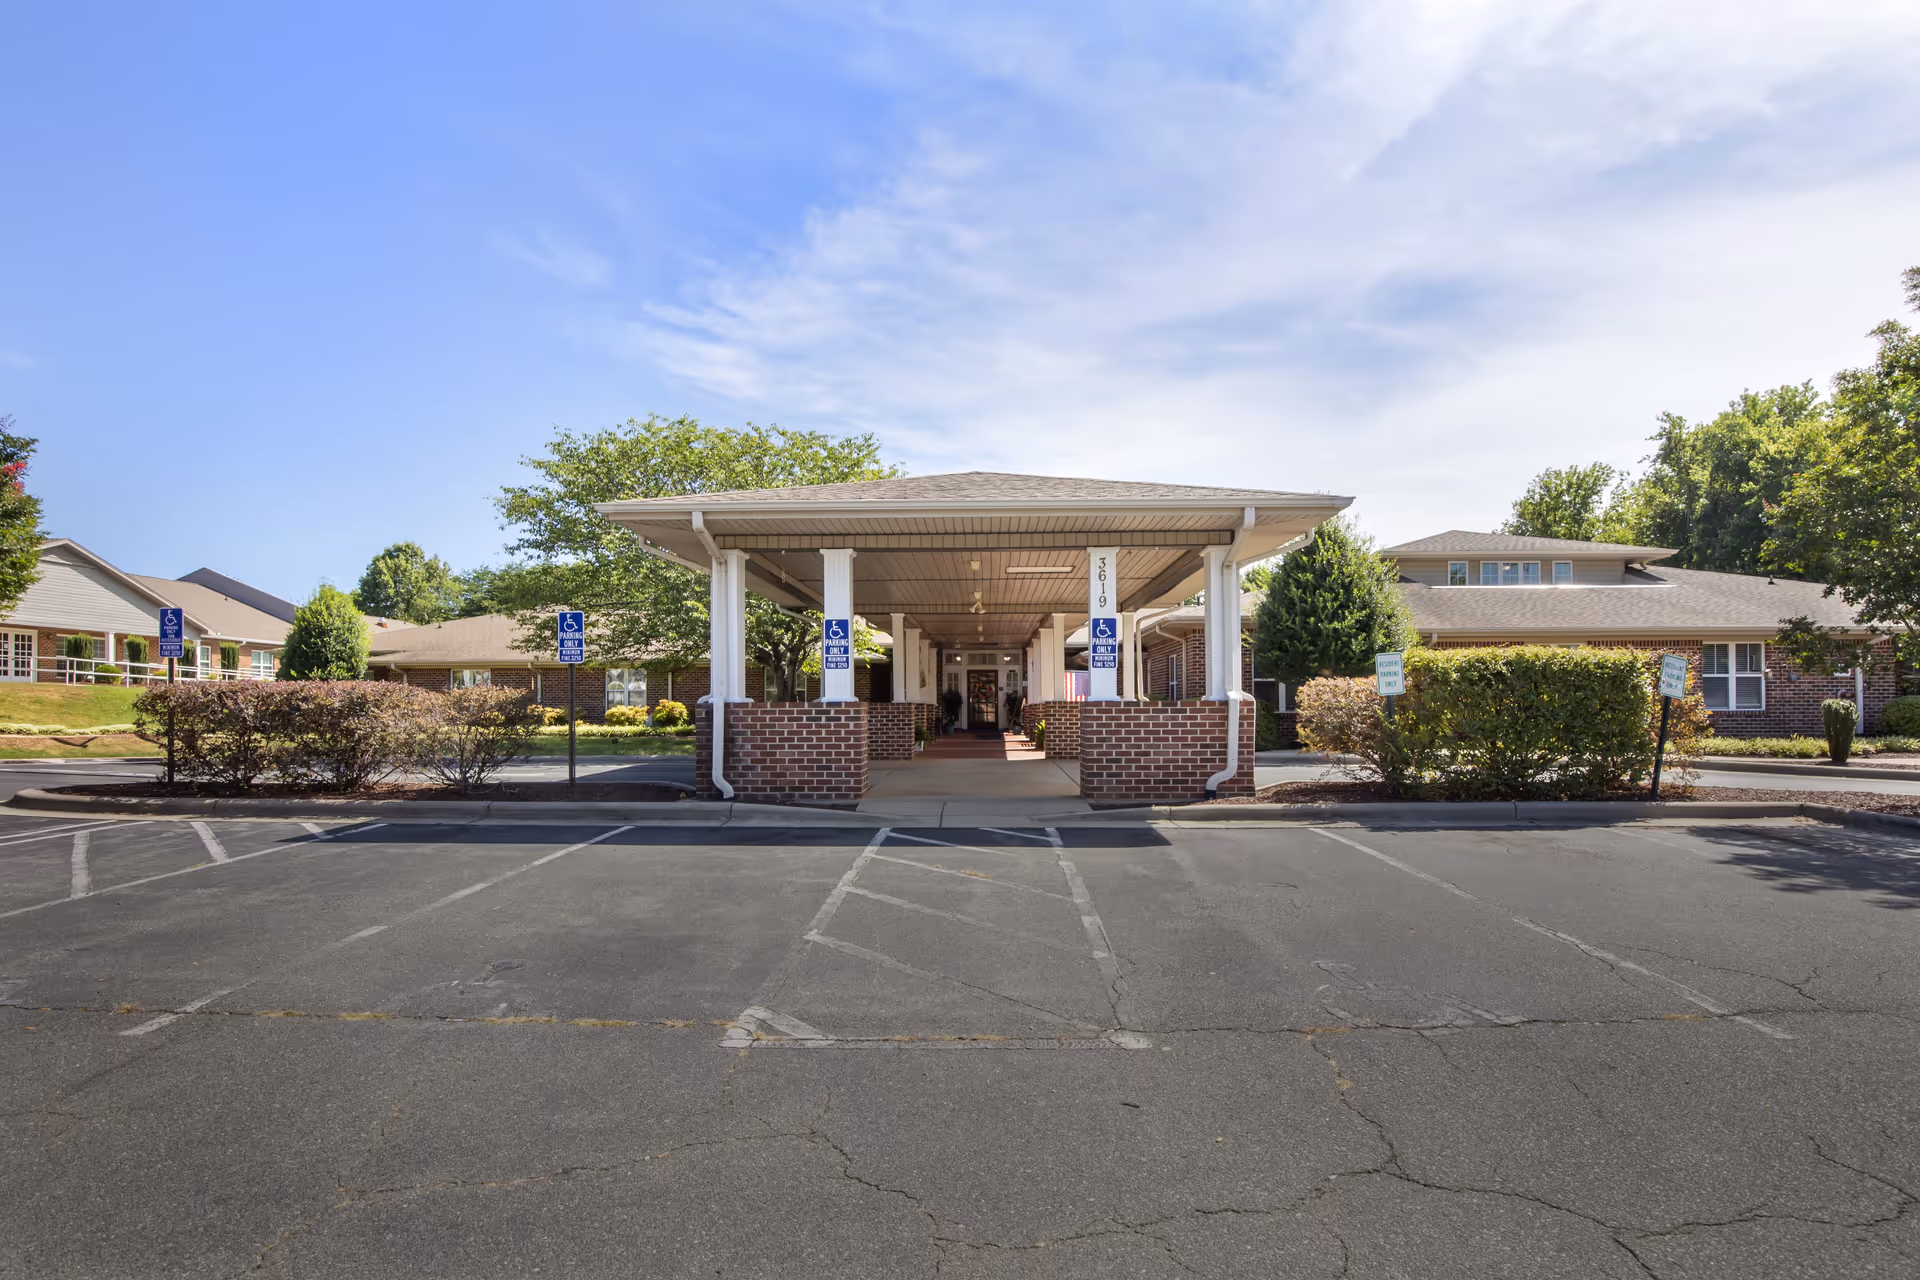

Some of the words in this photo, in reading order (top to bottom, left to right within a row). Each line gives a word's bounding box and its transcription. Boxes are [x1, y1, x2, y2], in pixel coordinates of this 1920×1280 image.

[1098, 556, 1107, 608] 3619
[560, 632, 582, 640] PARKING
[564, 640, 578, 648] ONLY
[826, 638, 848, 646] PARKING
[1092, 638, 1116, 646] PARKING
[830, 646, 844, 654] ONLY
[1096, 646, 1112, 654] ONLY
[1664, 672, 1682, 681] PARKING
